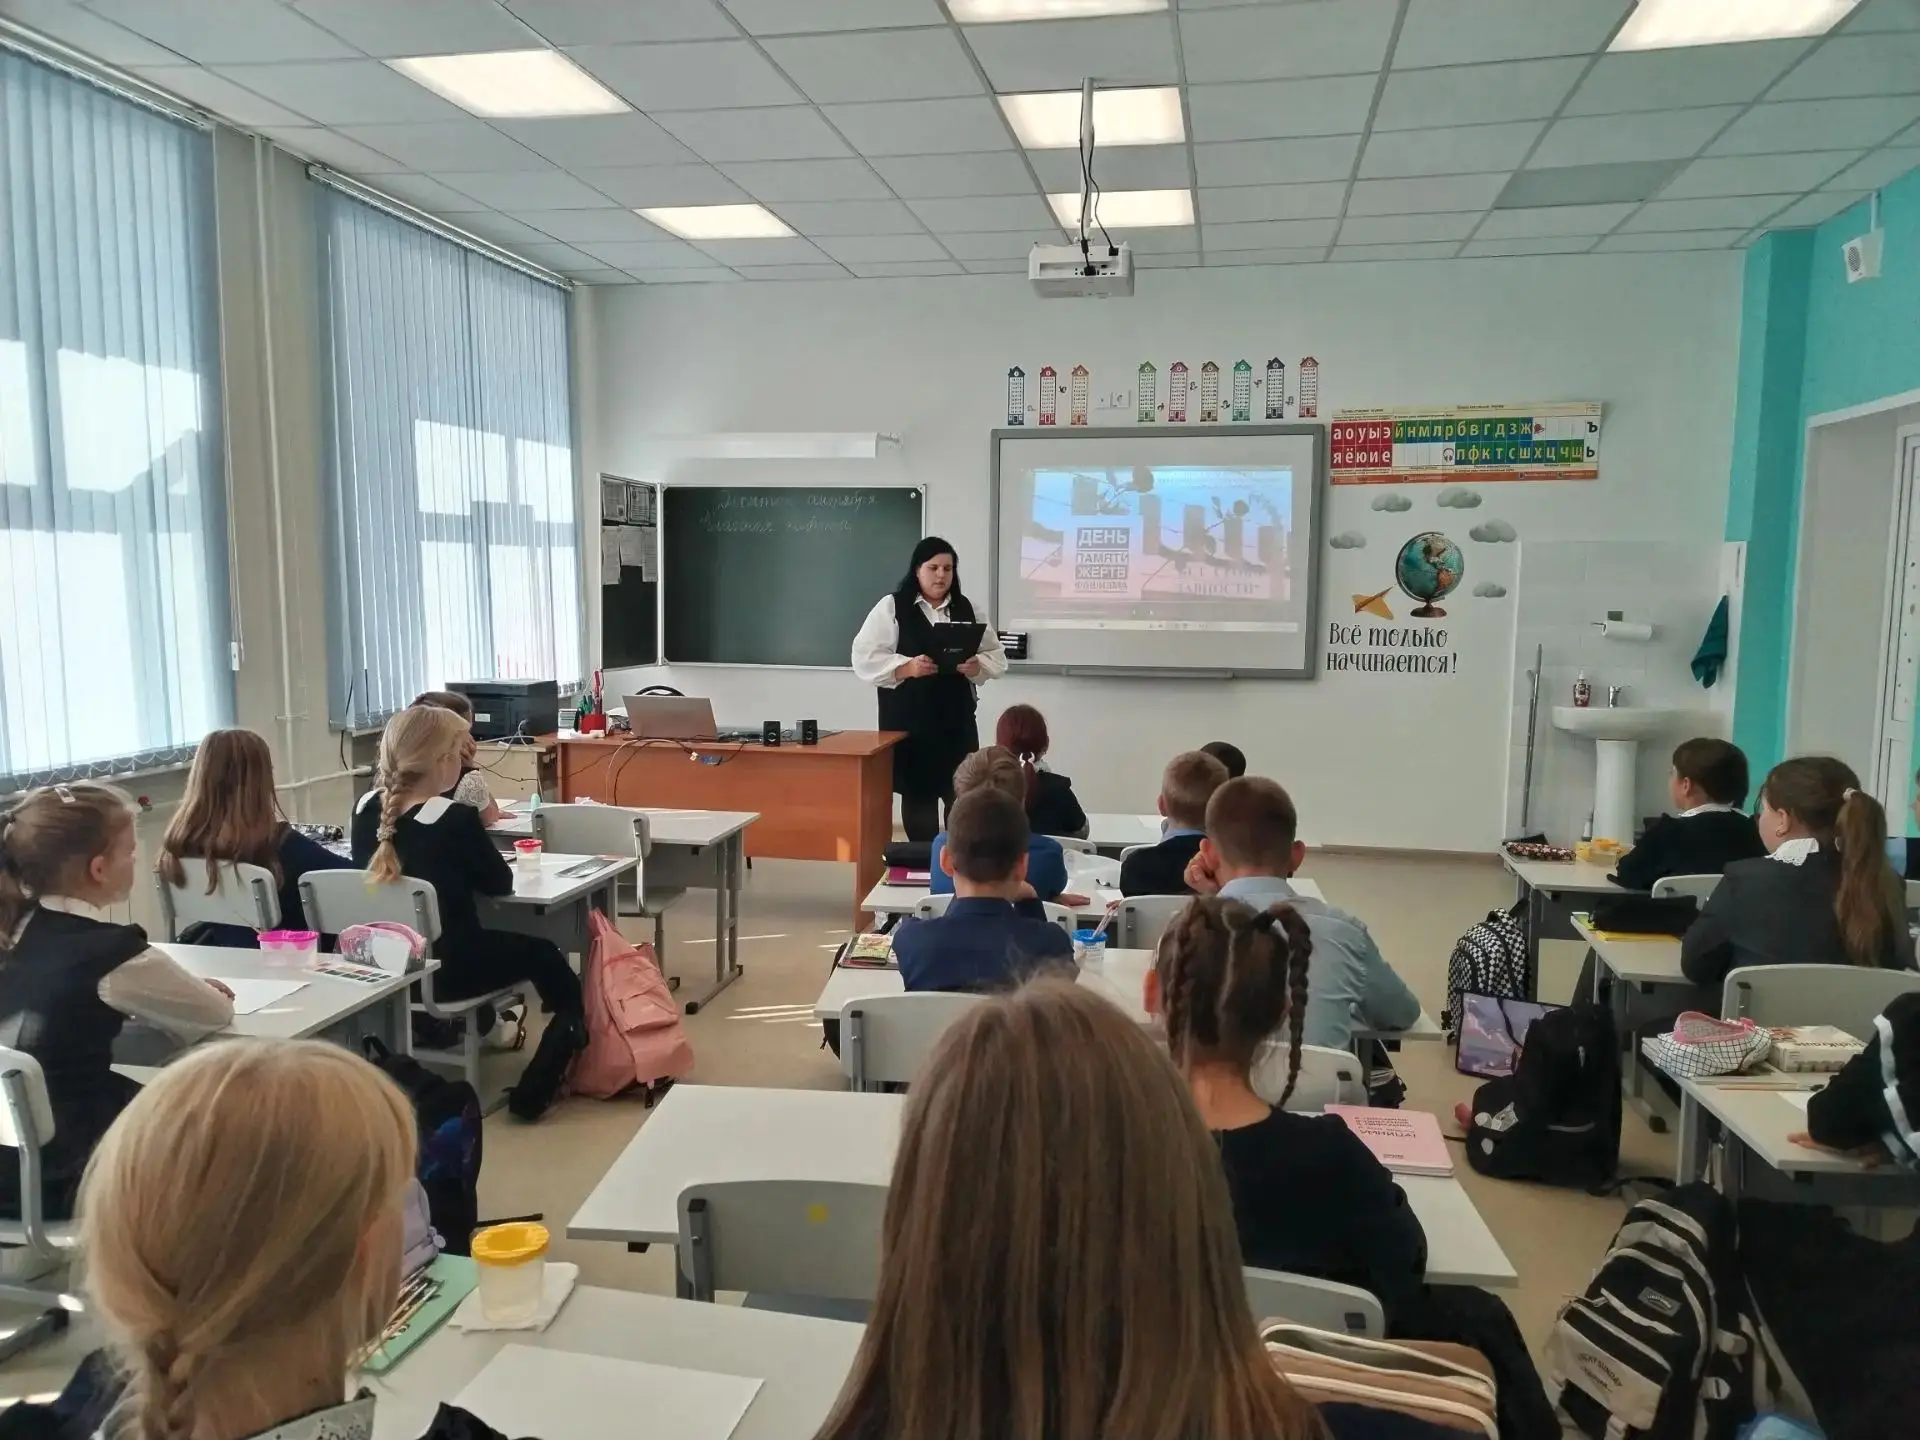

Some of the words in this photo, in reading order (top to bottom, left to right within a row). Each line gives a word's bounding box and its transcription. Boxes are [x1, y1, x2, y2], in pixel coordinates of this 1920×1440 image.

[1078, 529, 1128, 547] ДЕНЬ
[1076, 551, 1128, 565] ПАМЯТИ
[1077, 566, 1126, 578] ЖЕРТВ
[1329, 622, 1362, 645] Всё
[1369, 626, 1448, 648] только
[1327, 651, 1457, 674] начинается!
